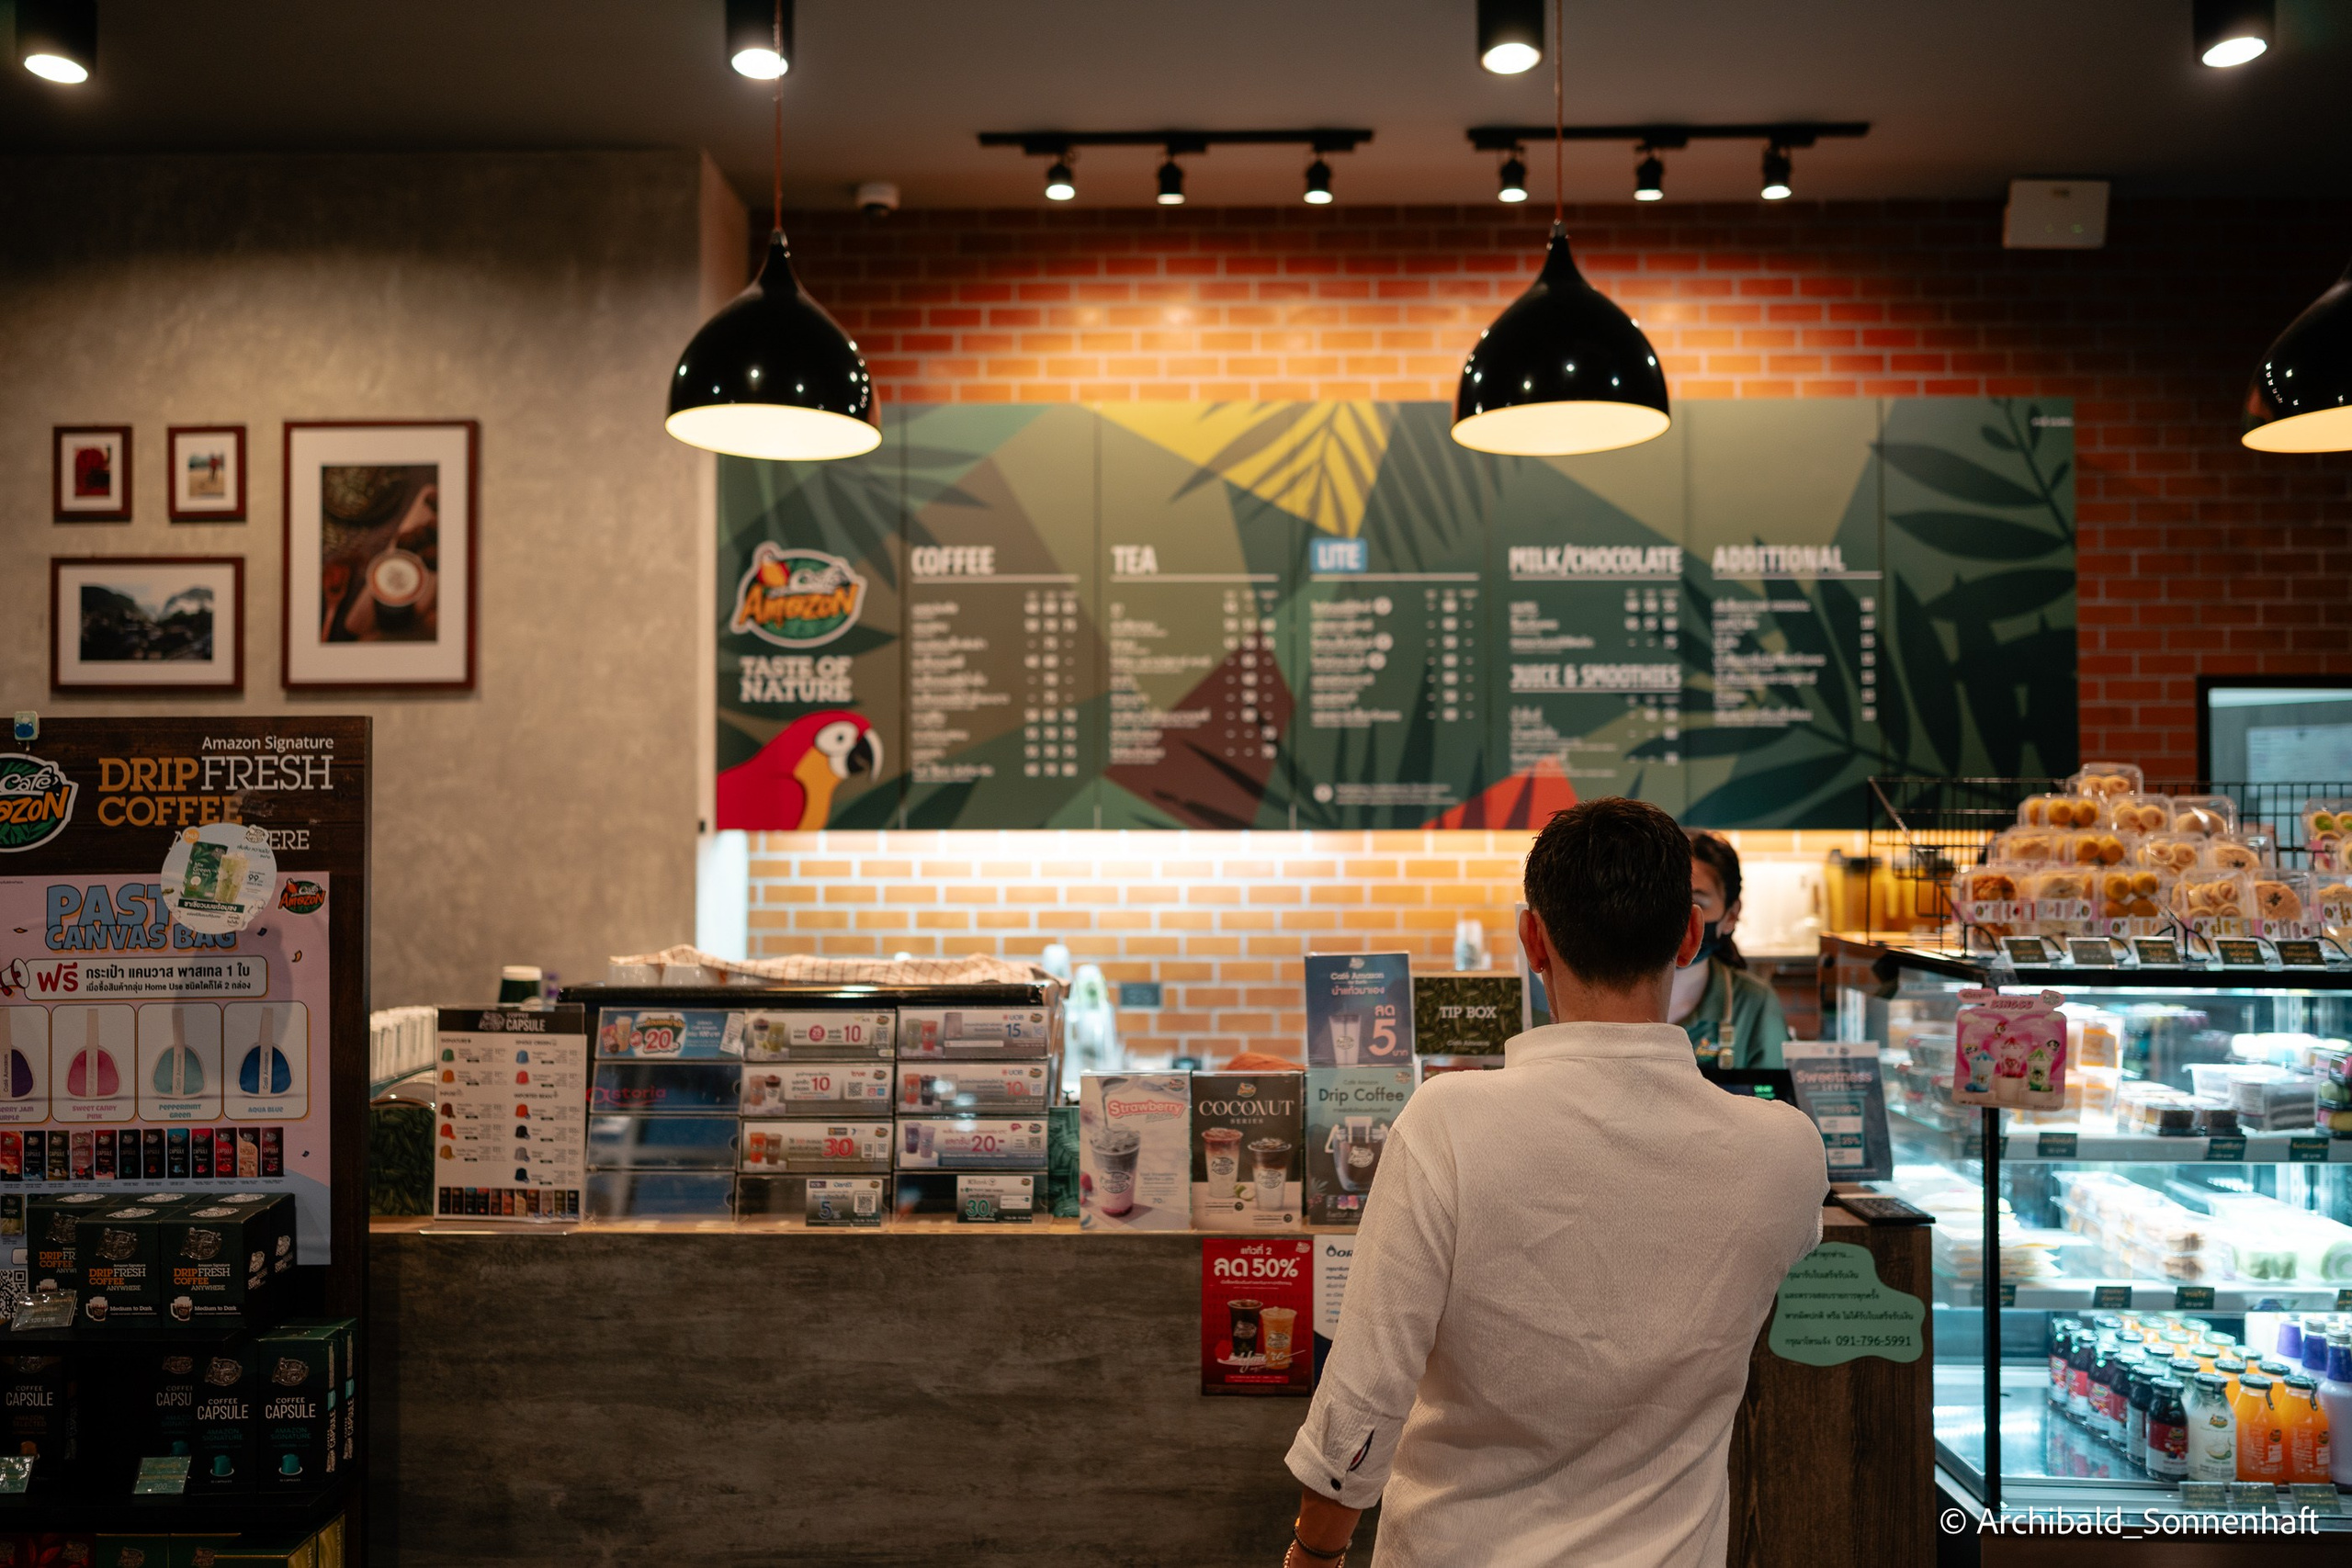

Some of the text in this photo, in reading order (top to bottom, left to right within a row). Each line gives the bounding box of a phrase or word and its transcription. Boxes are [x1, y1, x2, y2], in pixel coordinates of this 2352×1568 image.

[911, 546, 995, 575] COFFEE
[1111, 545, 1158, 575] TEA
[1317, 543, 1362, 570] LITE
[1509, 544, 1683, 576] MILK/CHOCOLATE
[1713, 545, 1847, 573] ADDITIONAL
[739, 654, 853, 678] TASTE OF
[1510, 663, 1559, 688] JUICE
[740, 676, 853, 703] NATURE
[201, 736, 334, 753] Amazon Signature
[97, 754, 334, 793] DRIP FRESH
[97, 795, 243, 827] COFFEE
[45, 923, 237, 951] CANVAS BAG
[38, 962, 78, 992] ฟรี
[86, 963, 250, 979] กระเป๋า แคนวาส พาสเทล 1 ใบ
[145, 983, 166, 991] Home
[1374, 1004, 1396, 1017] ลด
[1439, 1006, 1498, 1019] TIP BOX
[506, 1019, 547, 1032] CAPSULE
[844, 1025, 861, 1042] 10
[1005, 1023, 1021, 1037] 15
[645, 1028, 672, 1050] 20
[1368, 1019, 1397, 1056] 5
[811, 1077, 831, 1090] 10
[1796, 1070, 1872, 1083] Sweetness
[1319, 1088, 1404, 1105] Drip Coffee
[1109, 1100, 1183, 1118] Strawberry
[1199, 1100, 1295, 1116] COCONUT
[822, 1138, 854, 1156] 30
[819, 1201, 832, 1219] 5
[40, 1251, 62, 1260] DRIP
[89, 1268, 146, 1277] DRIP FRESH
[174, 1268, 231, 1277] DRIP FRESH
[1214, 1258, 1249, 1277] ลด
[1836, 1336, 1911, 1346] 091-796-5991
[6, 1392, 53, 1406] CAPSULE
[198, 1404, 249, 1420] CAPSULE
[266, 1404, 316, 1419] CAPSULE
